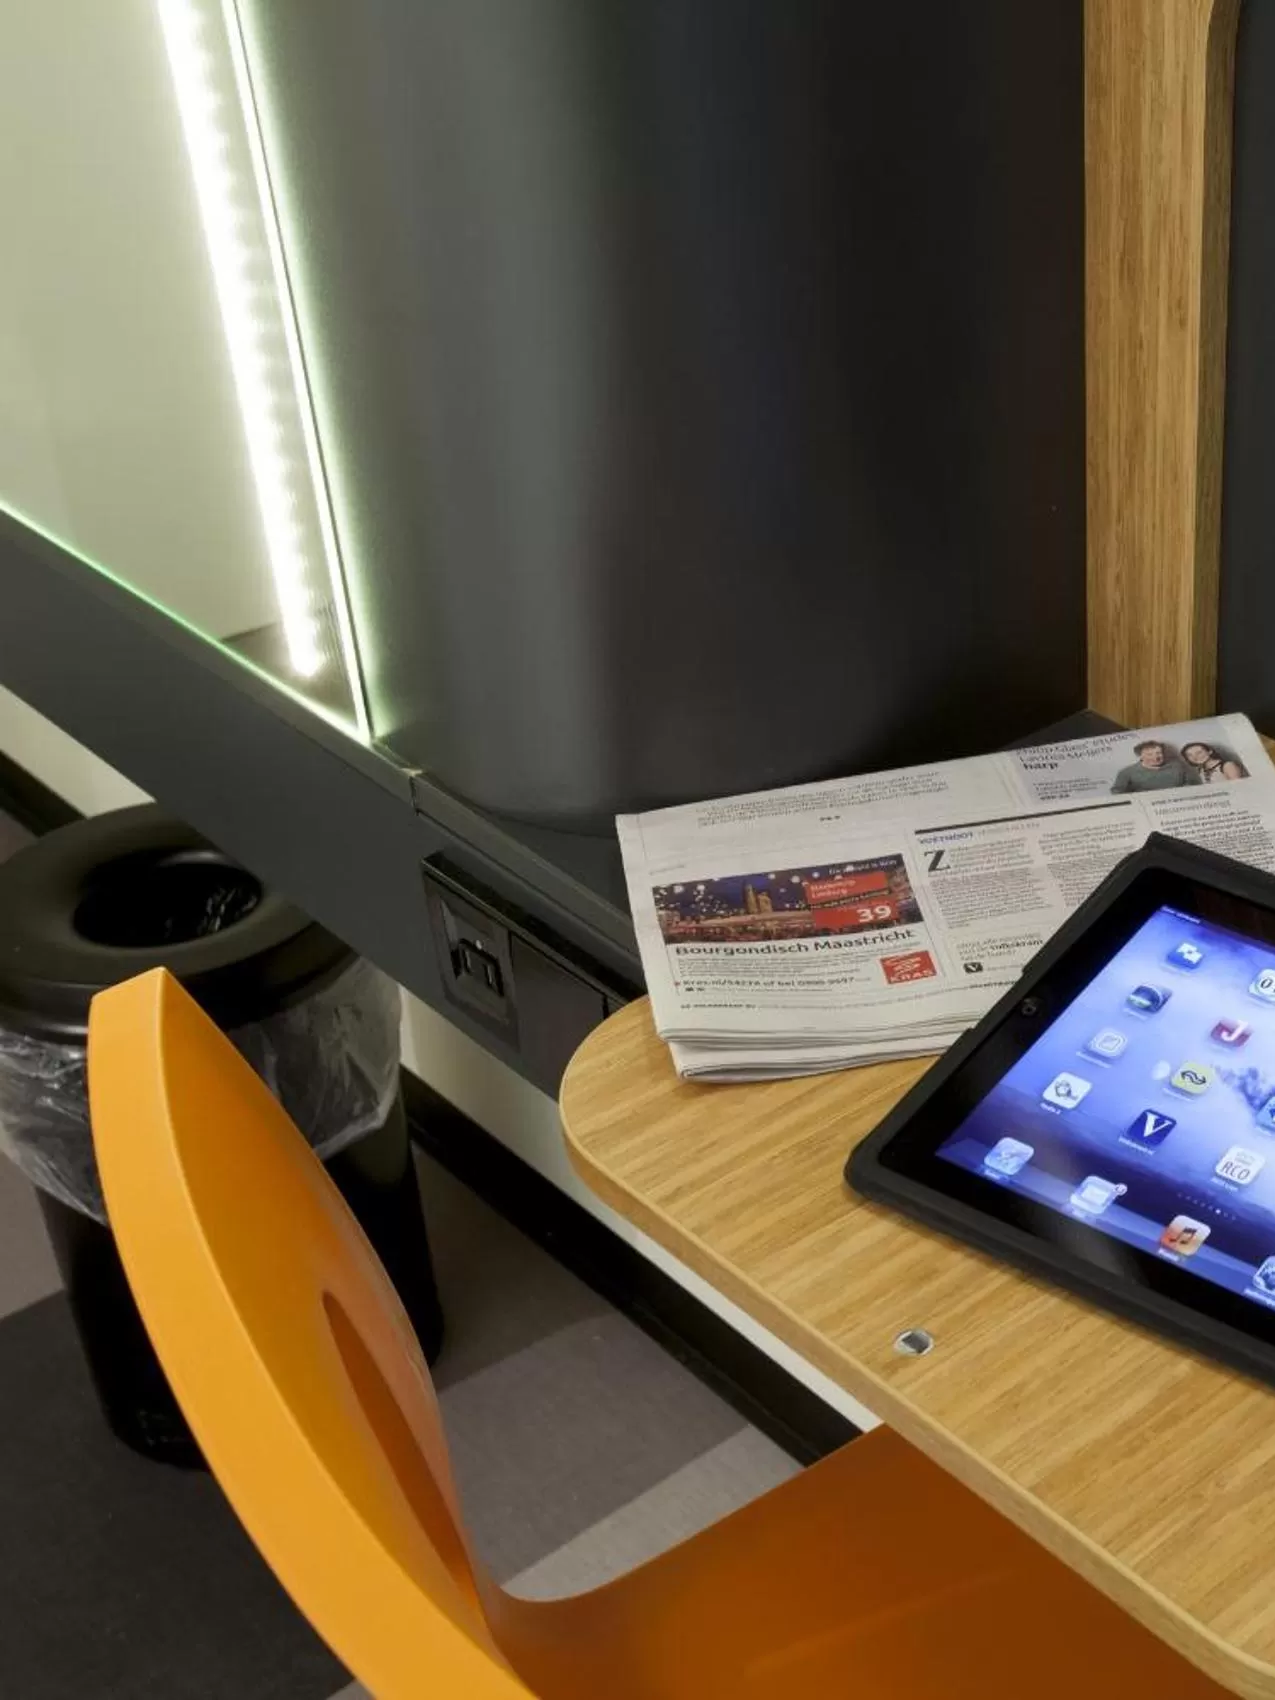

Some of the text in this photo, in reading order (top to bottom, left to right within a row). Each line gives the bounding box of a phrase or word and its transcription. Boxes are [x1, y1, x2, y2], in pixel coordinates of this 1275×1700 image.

[923, 849, 952, 872] Z
[856, 904, 893, 922] 39
[675, 928, 918, 957] Bourgondisch Maastricht
[890, 970, 934, 982] KRAS
[1220, 1019, 1249, 1042] J
[1143, 1111, 1173, 1138] V
[1220, 1160, 1251, 1181] RCO
